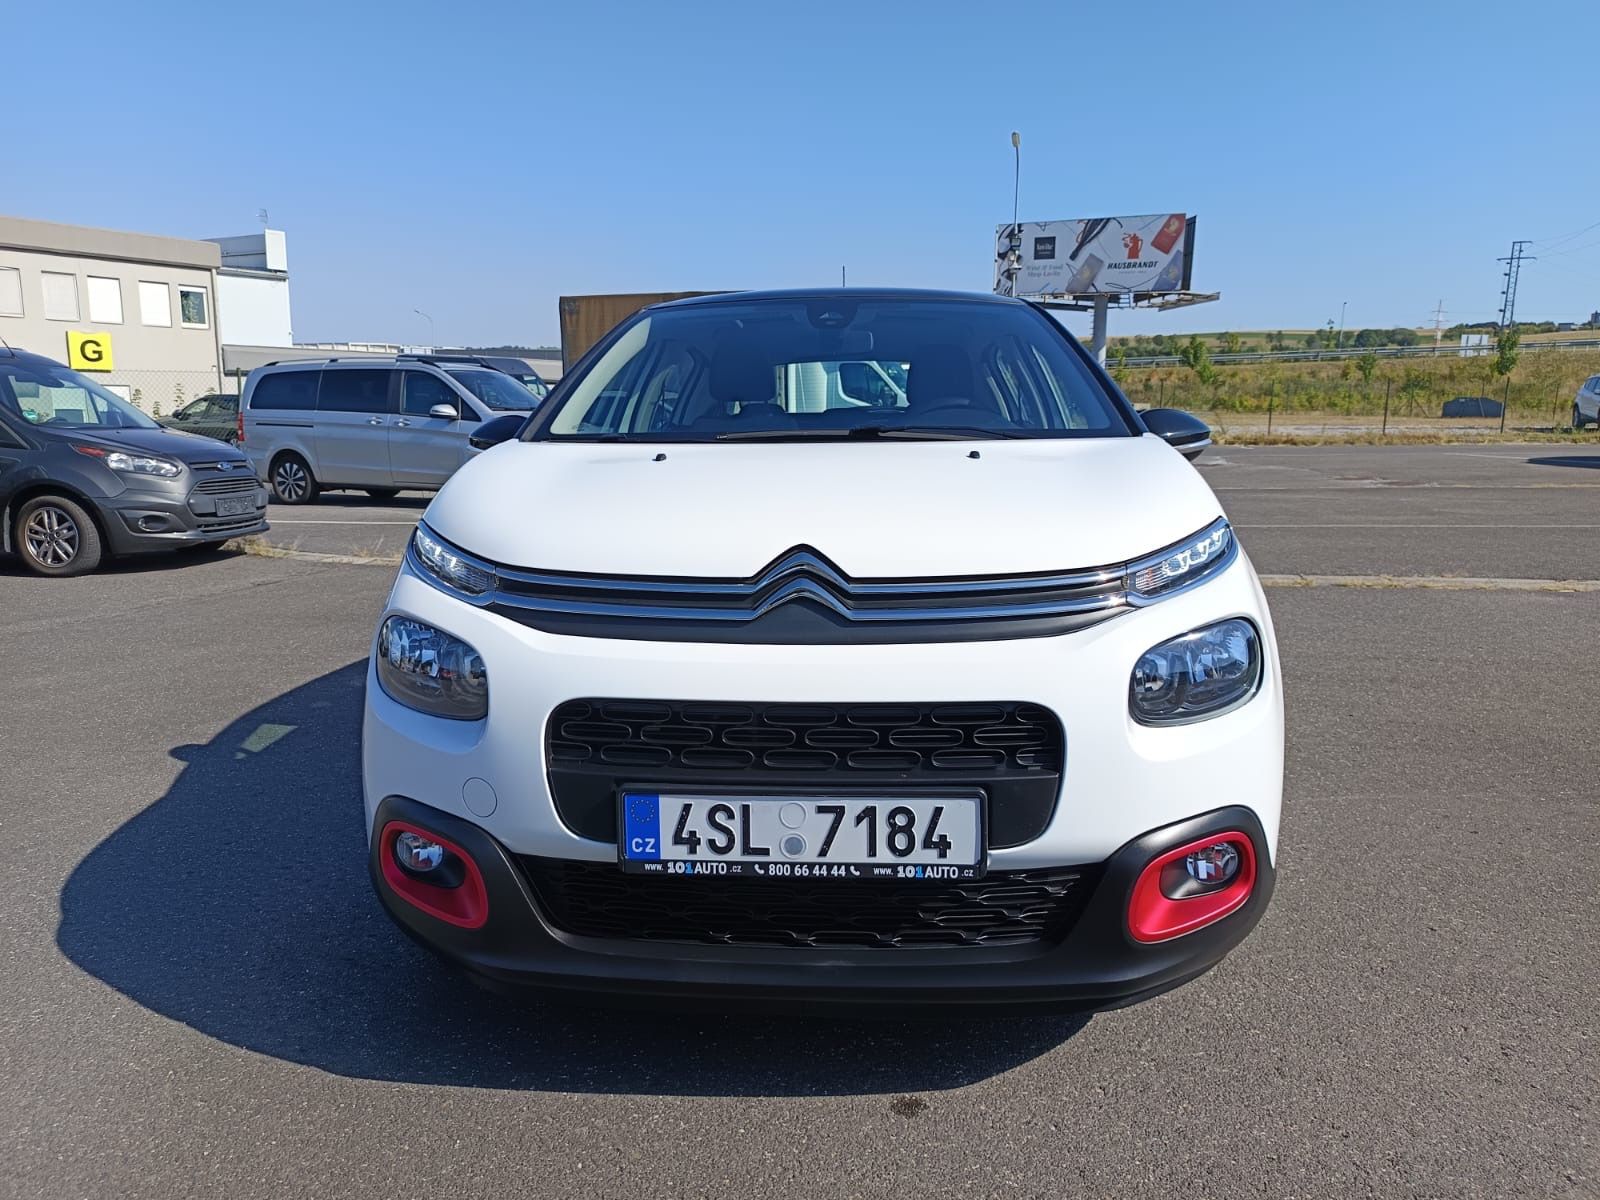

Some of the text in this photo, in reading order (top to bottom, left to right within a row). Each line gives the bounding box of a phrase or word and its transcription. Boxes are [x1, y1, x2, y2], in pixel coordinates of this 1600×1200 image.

[1107, 261, 1159, 270] HAUSBRANDT
[80, 339, 103, 362] G
[672, 803, 952, 859] 4SL 7184
[631, 837, 656, 853] CZ
[768, 863, 847, 877] 800 66 44 44
